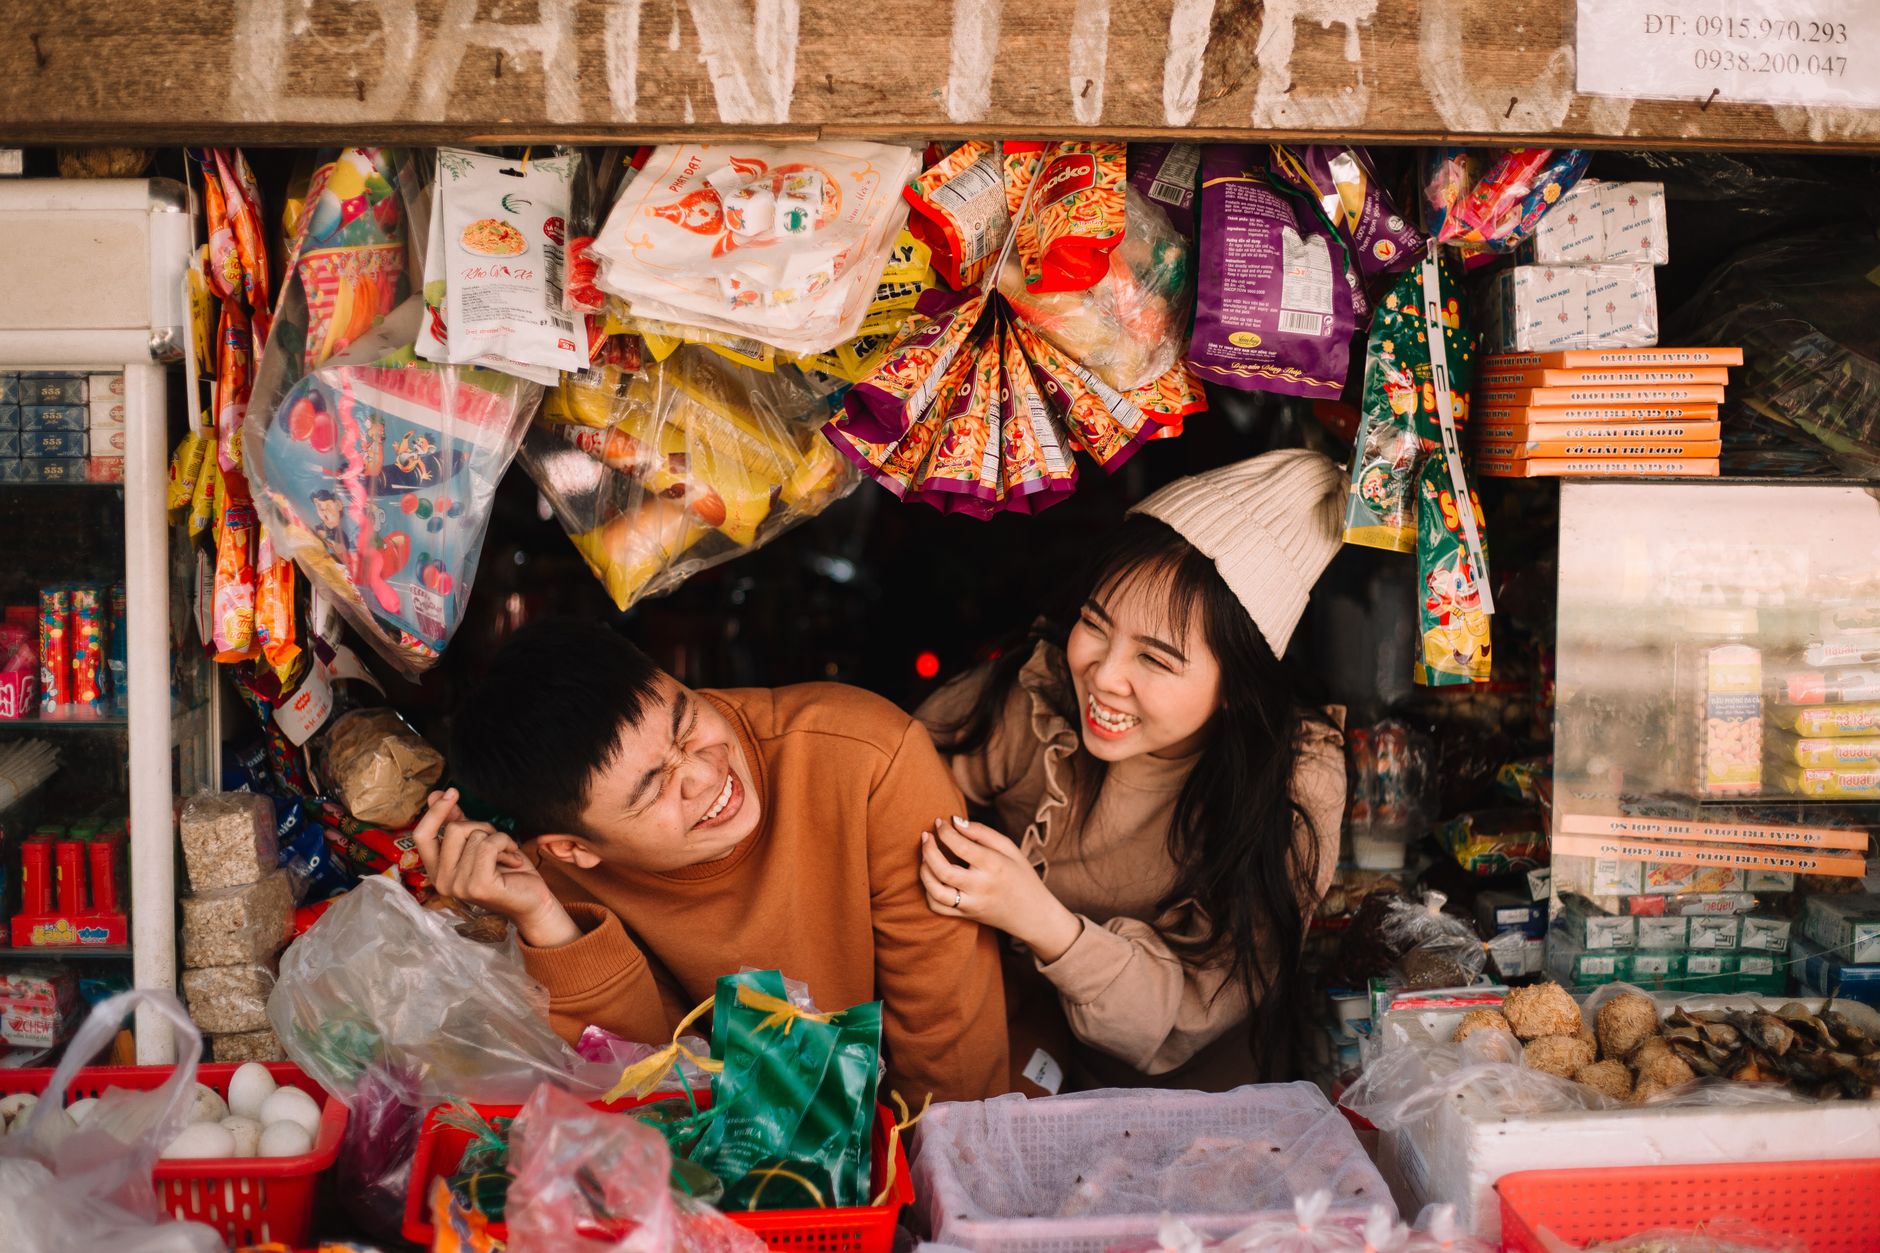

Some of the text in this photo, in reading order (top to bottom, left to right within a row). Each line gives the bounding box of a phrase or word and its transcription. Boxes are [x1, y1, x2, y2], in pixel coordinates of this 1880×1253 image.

[1643, 13, 1849, 45] ĐT: 0915.970.293
[1694, 48, 1848, 78] 0938.200.047
[1600, 354, 1632, 362] LOTO
[1581, 374, 1615, 382] LOTO
[1423, 380, 1471, 418] Sbi
[1571, 392, 1605, 400] LOTO
[1565, 410, 1600, 418] LOTO
[1648, 428, 1684, 436] LOTO
[1648, 446, 1684, 454] LOTO
[1567, 463, 1601, 471] LOTO
[1703, 828, 1738, 838] LOTO
[1695, 851, 1732, 862] LOTO
